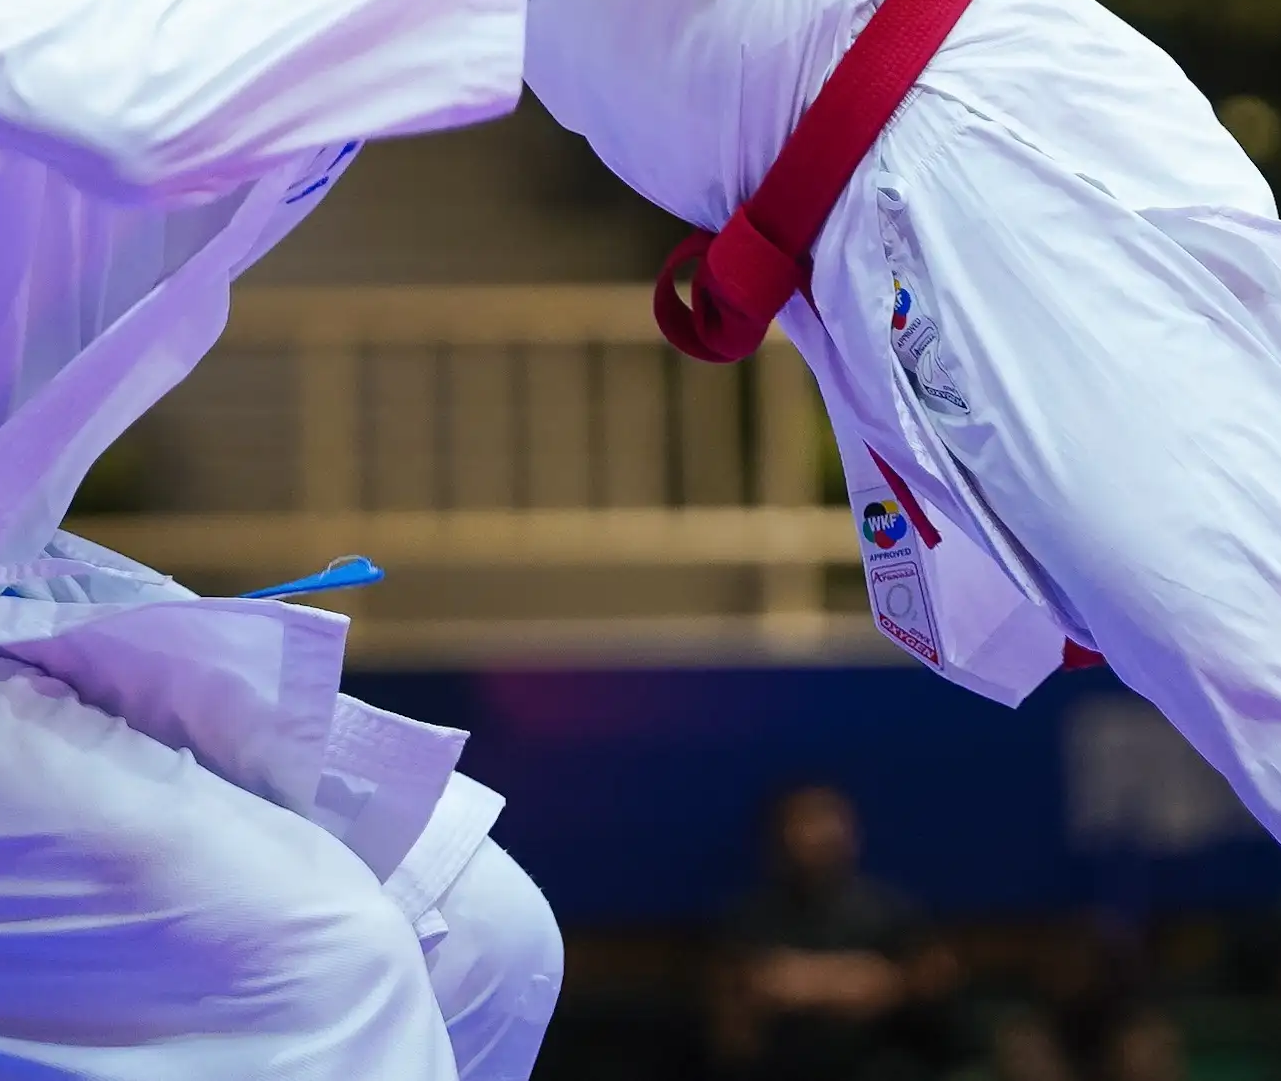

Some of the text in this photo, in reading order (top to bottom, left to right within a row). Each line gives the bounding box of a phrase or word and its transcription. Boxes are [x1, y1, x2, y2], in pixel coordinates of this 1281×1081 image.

[897, 318, 922, 348] APPROVED
[868, 514, 897, 532] WKF
[870, 548, 912, 562] APPROVED
[881, 619, 935, 658] OXYGEN
